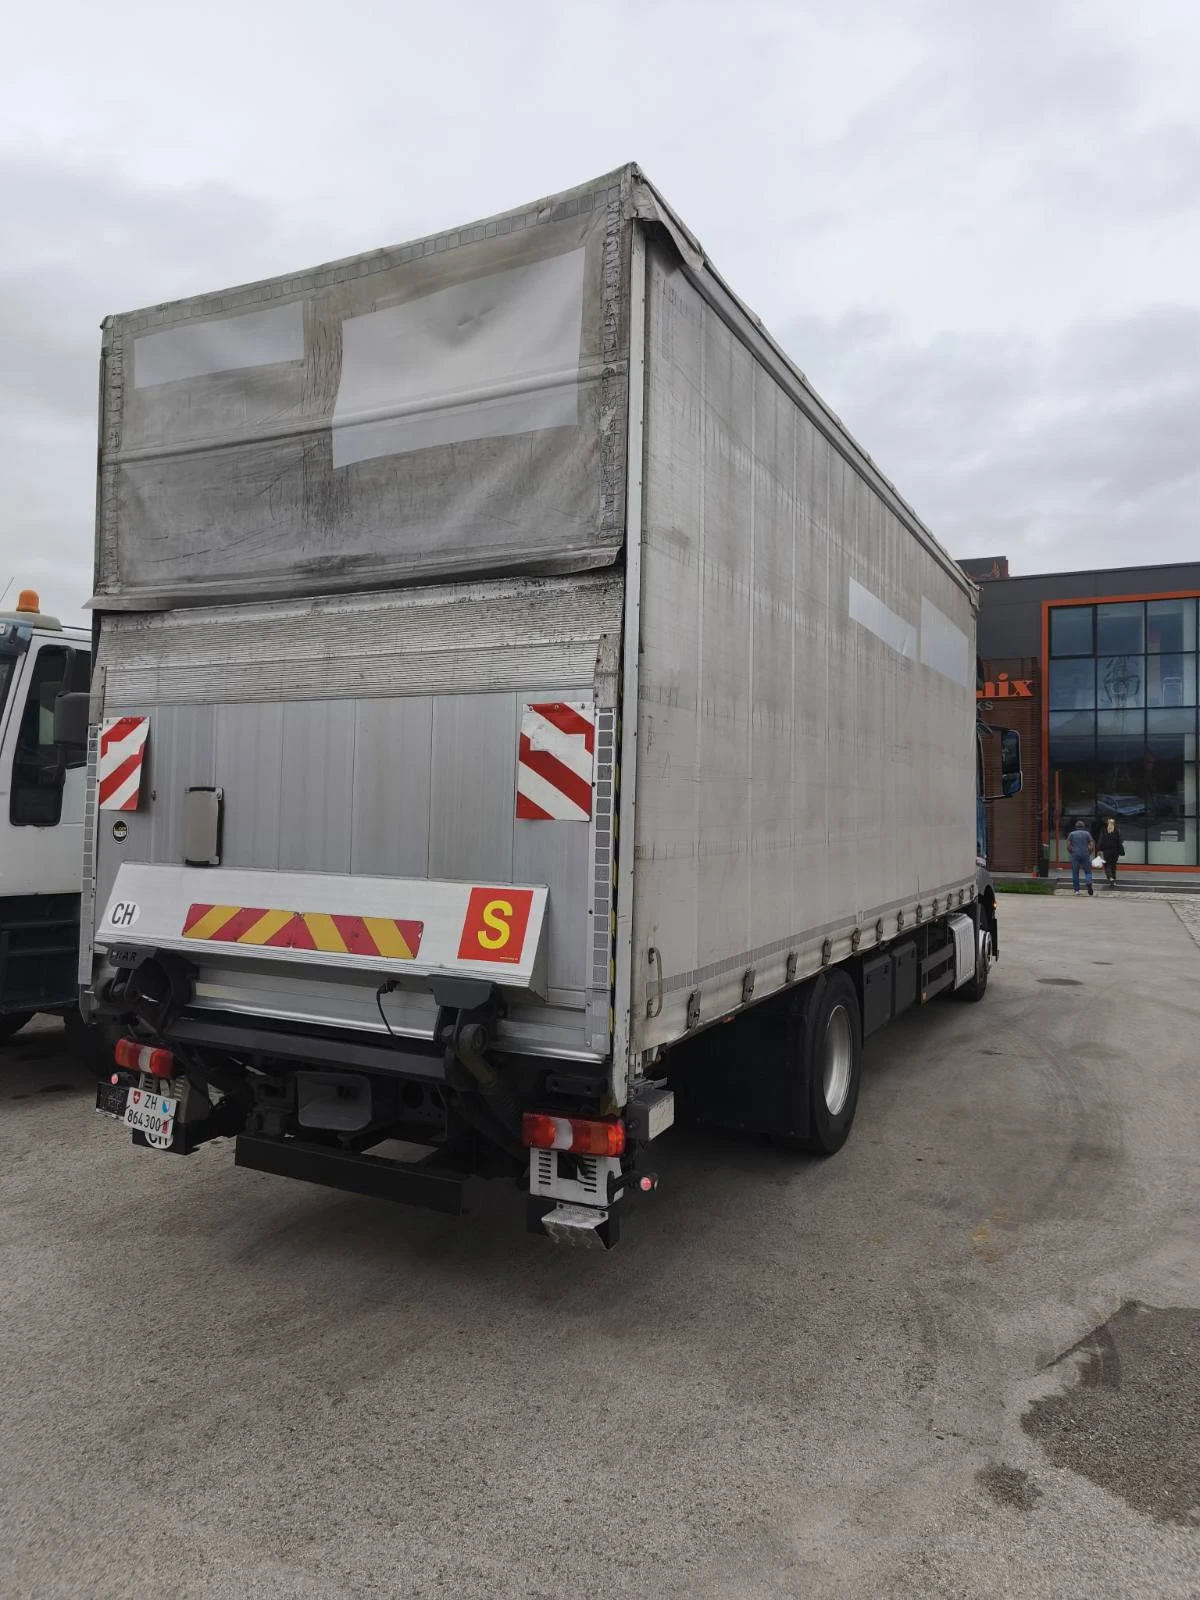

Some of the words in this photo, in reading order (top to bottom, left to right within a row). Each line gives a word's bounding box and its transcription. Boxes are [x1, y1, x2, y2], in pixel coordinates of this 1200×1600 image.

[111, 903, 136, 925] CH
[477, 900, 513, 950] S
[144, 1094, 158, 1110] ZH
[127, 1109, 161, 1131] 864300
